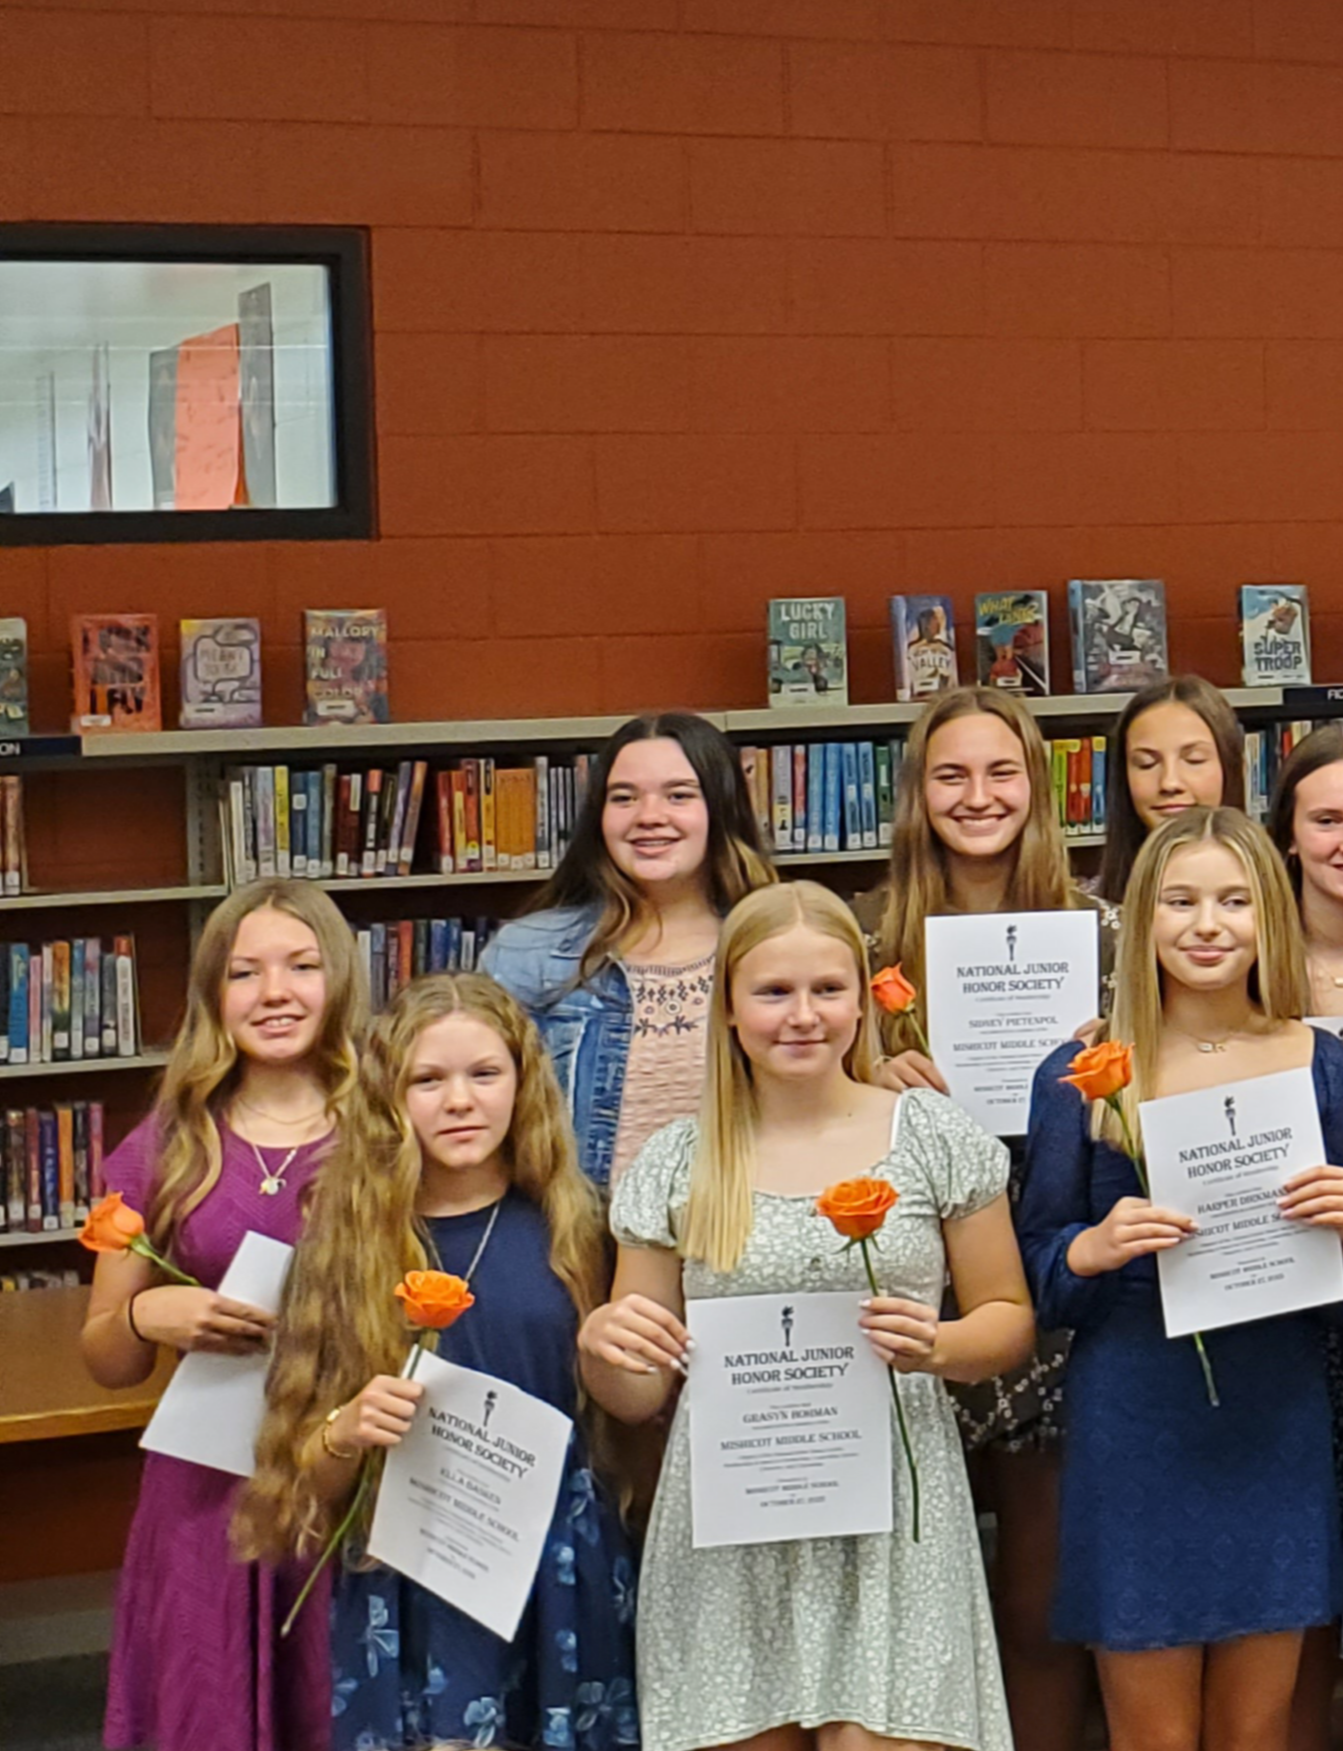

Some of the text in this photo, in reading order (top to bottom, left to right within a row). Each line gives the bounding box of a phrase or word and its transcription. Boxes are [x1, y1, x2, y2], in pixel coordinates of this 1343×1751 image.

[780, 602, 836, 621] LUCKY
[311, 626, 379, 638] MALLORY
[789, 621, 827, 639] GIRL
[1254, 636, 1301, 656] SUPER
[910, 657, 950, 671] VALLEY
[1255, 656, 1302, 672] TROOP
[957, 962, 1069, 978] NATIONAL JUNIOR
[963, 977, 1064, 993] HONOR SOCIETY
[1178, 1128, 1292, 1162] NATIONAL JUNIOR
[1187, 1144, 1289, 1178] HONOR SOCIETY
[724, 1347, 854, 1367] NATIONAL JUNIOR
[732, 1362, 849, 1385] HONOR SOCIETY
[429, 1407, 490, 1444] NATIONAL
[492, 1437, 536, 1467] JUNIOR
[818, 1430, 862, 1442] SCHOOL
[432, 1425, 472, 1450] HONOR
[475, 1444, 528, 1478] SOCIETY
